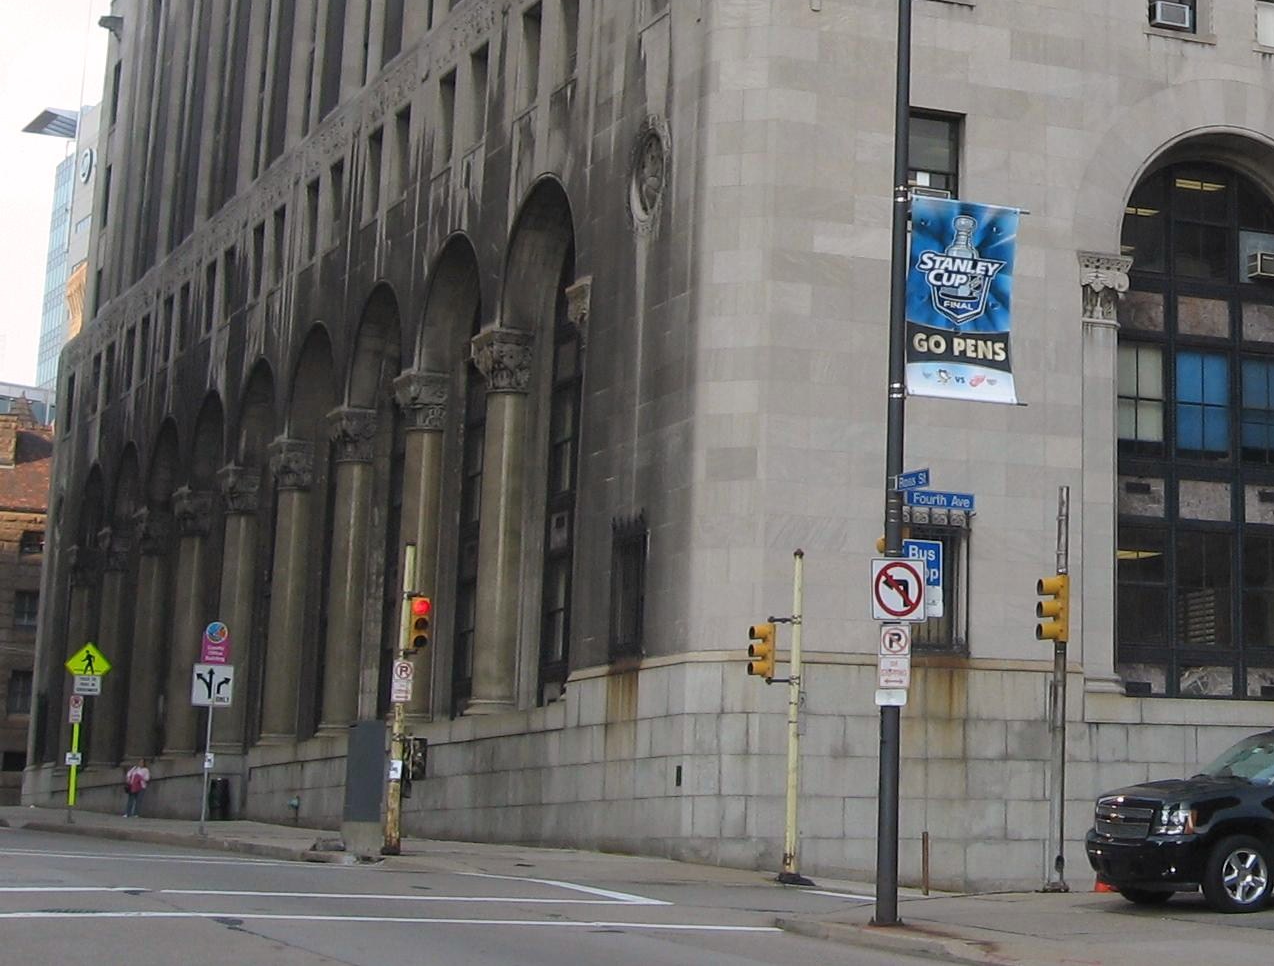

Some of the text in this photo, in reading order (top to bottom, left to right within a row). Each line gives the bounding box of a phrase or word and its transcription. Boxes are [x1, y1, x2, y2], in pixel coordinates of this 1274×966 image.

[919, 253, 1000, 276] STANLEY
[928, 269, 968, 287] CUP
[943, 300, 974, 311] FINAL
[913, 332, 1006, 361] GO PENS
[918, 472, 927, 485] St
[913, 492, 971, 508] Fourth Ave
[908, 544, 936, 562] Bus
